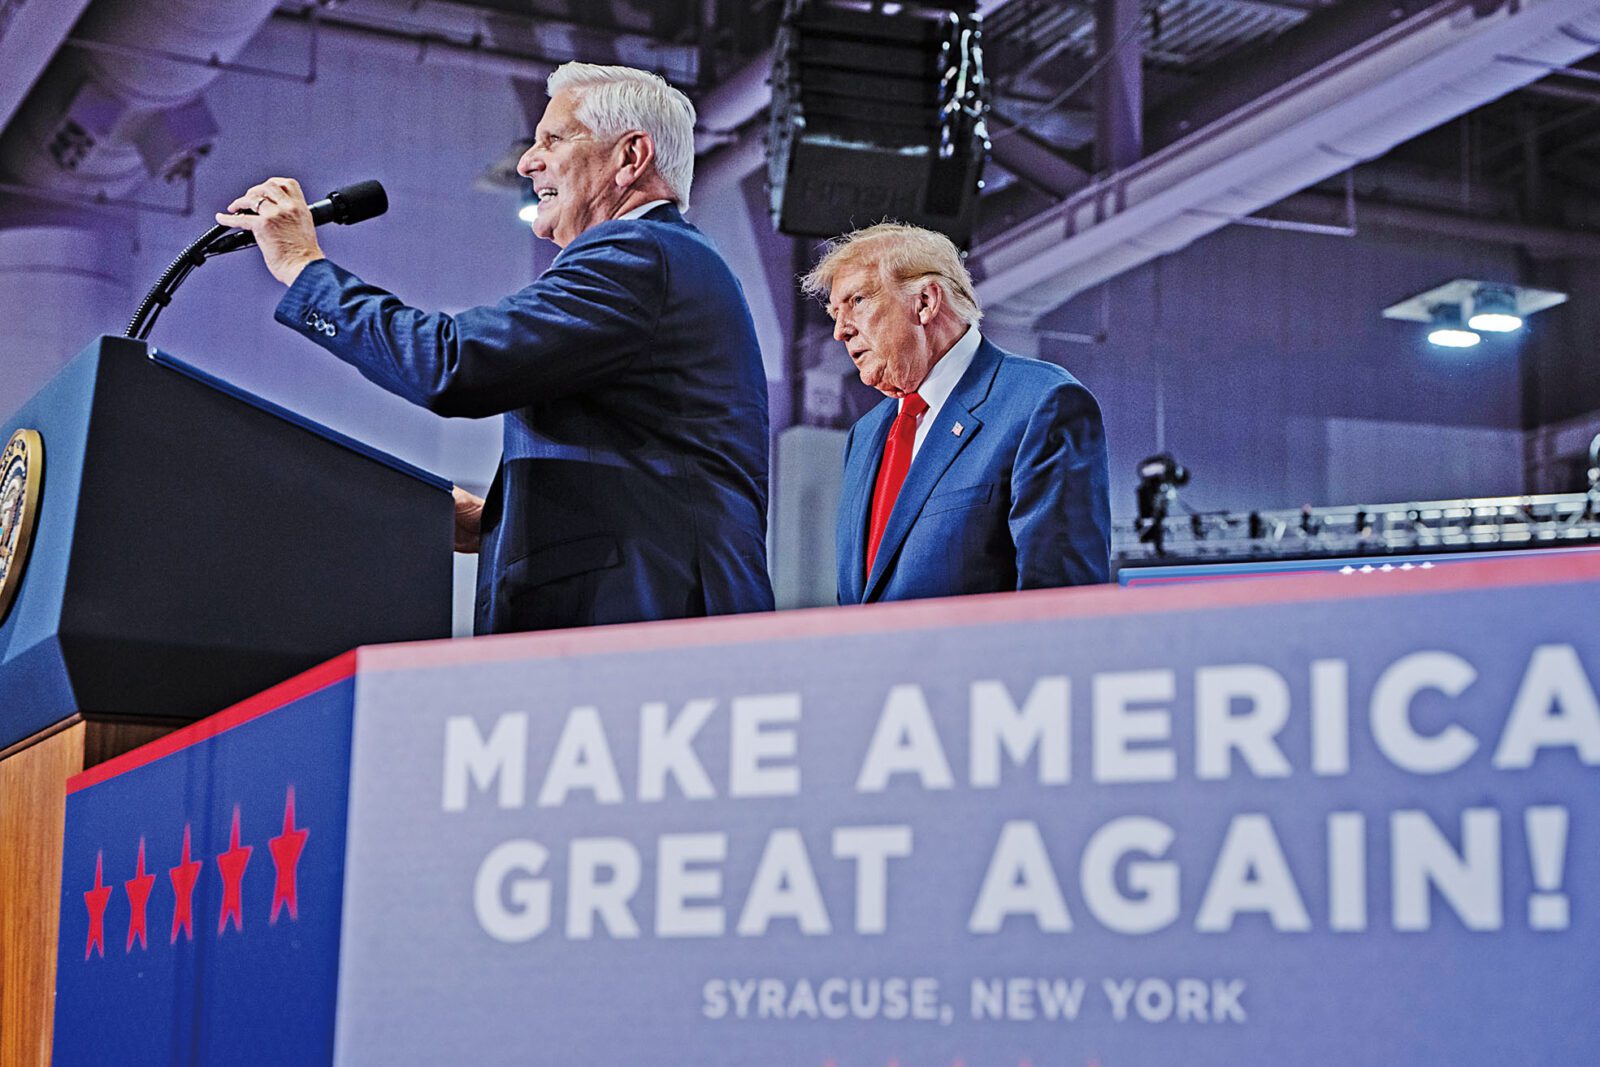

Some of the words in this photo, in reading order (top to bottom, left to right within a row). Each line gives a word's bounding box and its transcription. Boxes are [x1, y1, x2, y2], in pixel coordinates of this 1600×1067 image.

[442, 693, 801, 811] MAKE
[857, 644, 1600, 792] AMERICA
[474, 826, 912, 942] GREAT
[969, 805, 1570, 934] AGAIN!
[703, 978, 954, 1023] SYRACUSE,
[971, 979, 1085, 1020] NEW
[1103, 977, 1246, 1023] YORK
